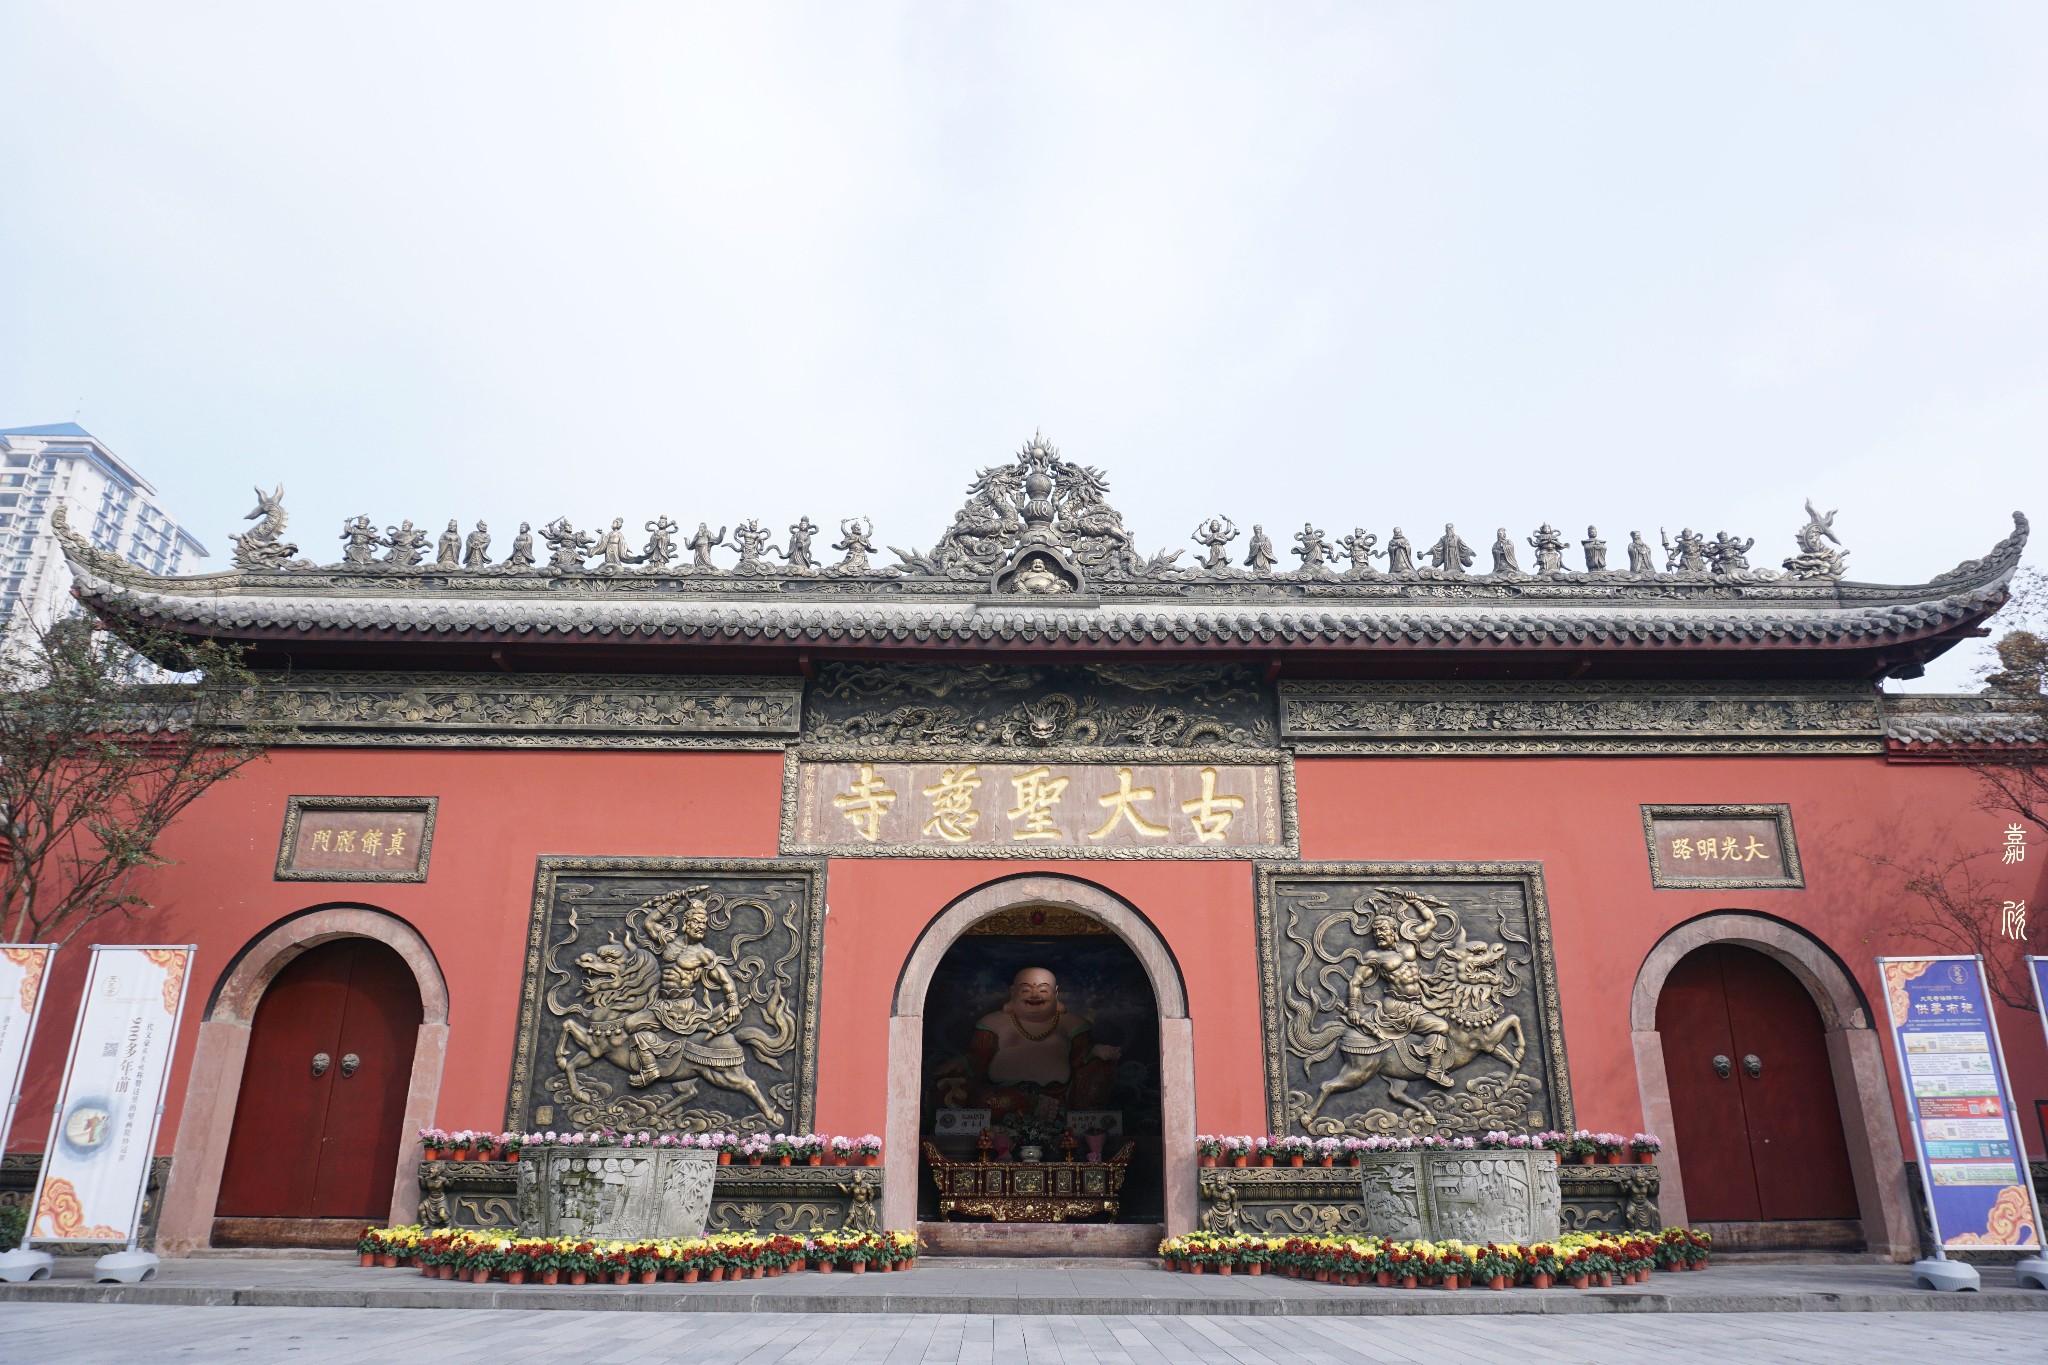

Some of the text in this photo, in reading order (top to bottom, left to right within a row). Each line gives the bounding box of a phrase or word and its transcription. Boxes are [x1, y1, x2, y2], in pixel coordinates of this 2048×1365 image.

[833, 763, 1245, 843] 古大聖慈寺
[1671, 835, 1770, 862] 大光明路
[114, 1016, 143, 1093] 900多年前
